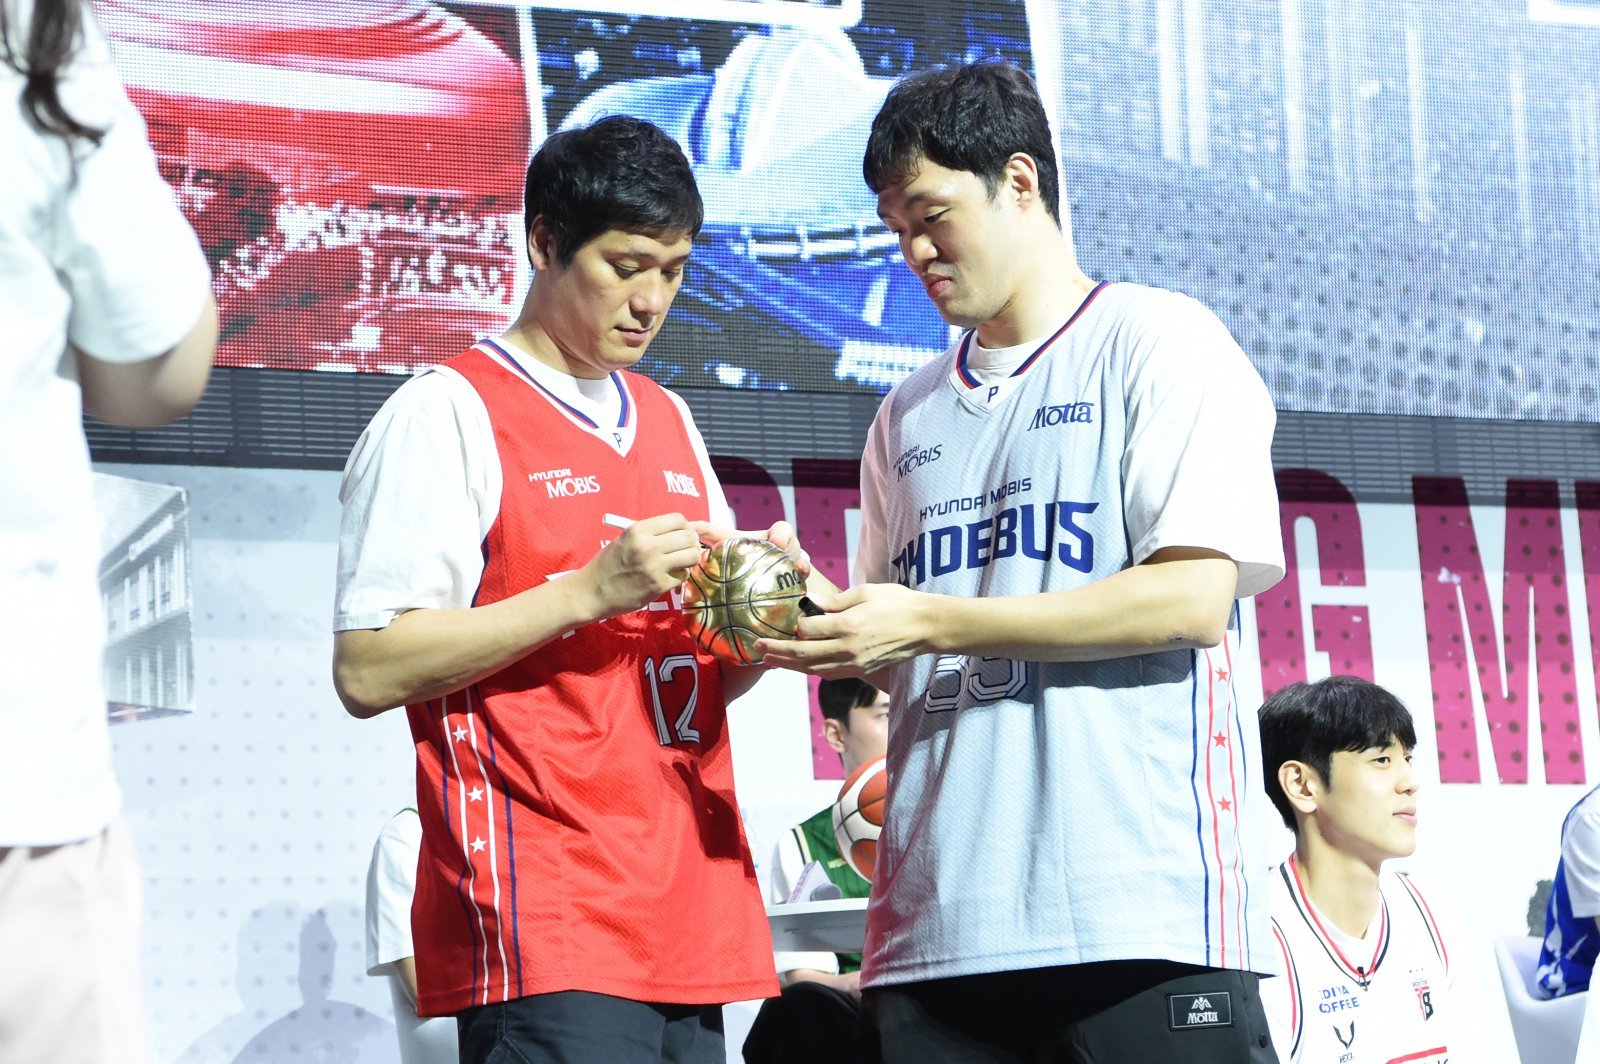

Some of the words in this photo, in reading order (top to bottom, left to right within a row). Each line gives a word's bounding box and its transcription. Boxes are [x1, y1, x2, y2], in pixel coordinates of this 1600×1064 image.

[986, 385, 999, 403] P
[1026, 401, 1095, 431] Motta
[613, 432, 622, 448] P
[897, 444, 943, 483] MOBIS
[528, 468, 572, 482] HYUNDAI
[545, 475, 601, 499] MOBIS
[919, 492, 988, 522] HYUNDAI
[989, 477, 1032, 505] MOBIS
[644, 653, 701, 747] 12
[1318, 996, 1361, 1014] COFFEE
[1186, 1011, 1219, 1025] Motta
